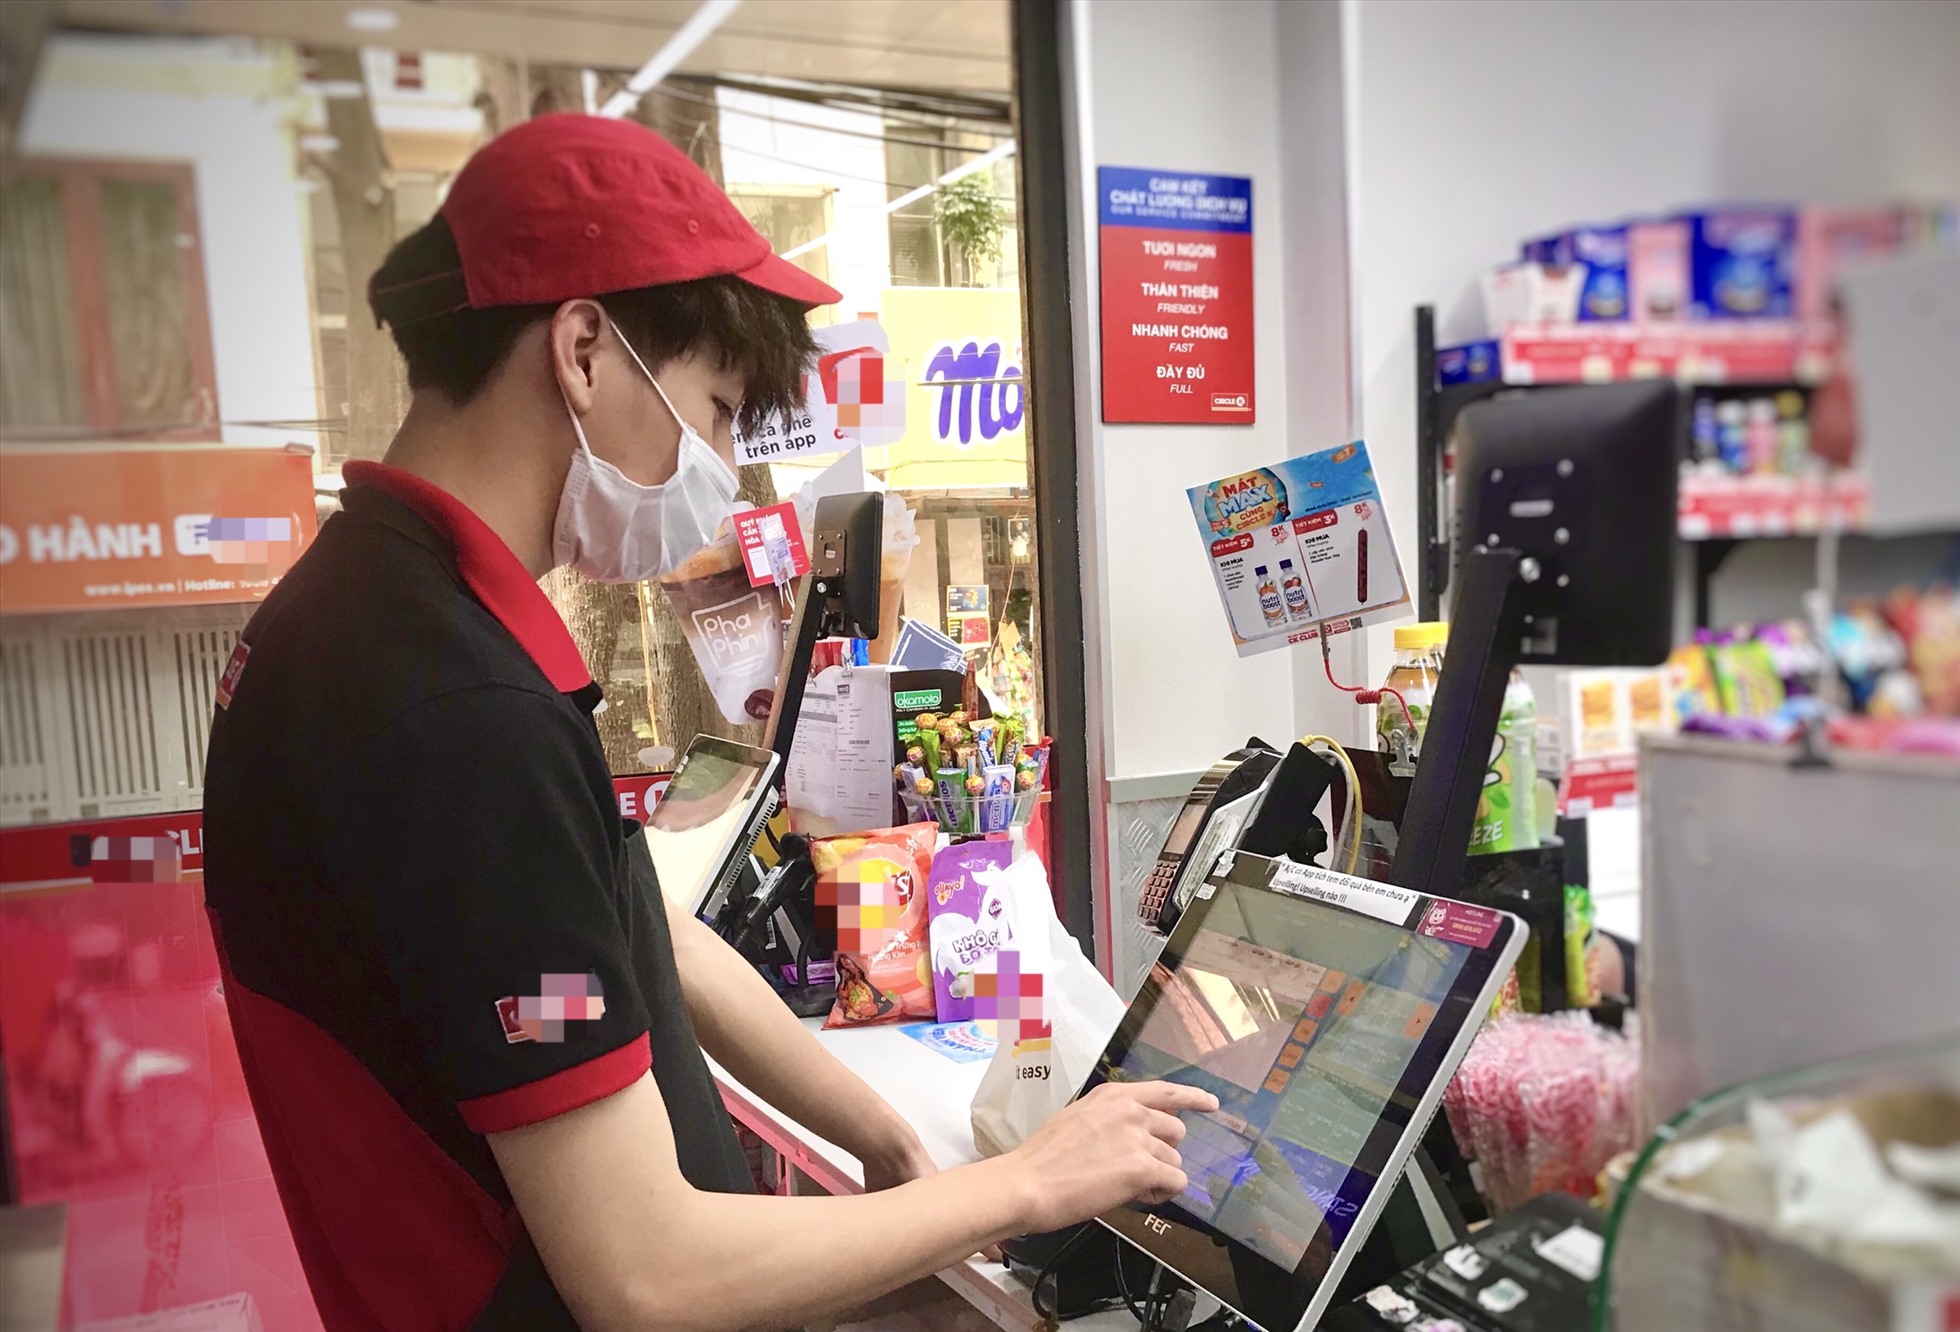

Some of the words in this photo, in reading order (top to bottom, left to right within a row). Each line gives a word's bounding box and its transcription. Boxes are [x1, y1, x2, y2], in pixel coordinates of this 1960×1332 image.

[1163, 259, 1198, 272] FRESH
[1157, 303, 1206, 314] FRIENDLY
[1132, 324, 1178, 337] NHANH
[1181, 324, 1228, 339] CHÓNG
[1168, 342, 1195, 353] FAST
[1156, 363, 1184, 378] ĐẦY
[1186, 363, 1205, 379] ĐỦ
[1170, 384, 1193, 394] FULL
[745, 441, 780, 459] trên
[785, 434, 816, 450] app
[1222, 476, 1257, 499] MÁT
[1217, 483, 1273, 518] MAX
[1236, 512, 1267, 531] CIRCLE
[27, 513, 163, 562] HÀNH
[185, 579, 235, 592] Hotline:
[1300, 631, 1318, 641] CLUB
[897, 692, 939, 707] okamoto
[1302, 868, 1315, 880] App
[1327, 874, 1339, 883] tem
[1375, 887, 1386, 896] em
[1299, 883, 1326, 899] Upselling
[952, 929, 987, 953] KHÔ
[1022, 1064, 1052, 1080] easy
